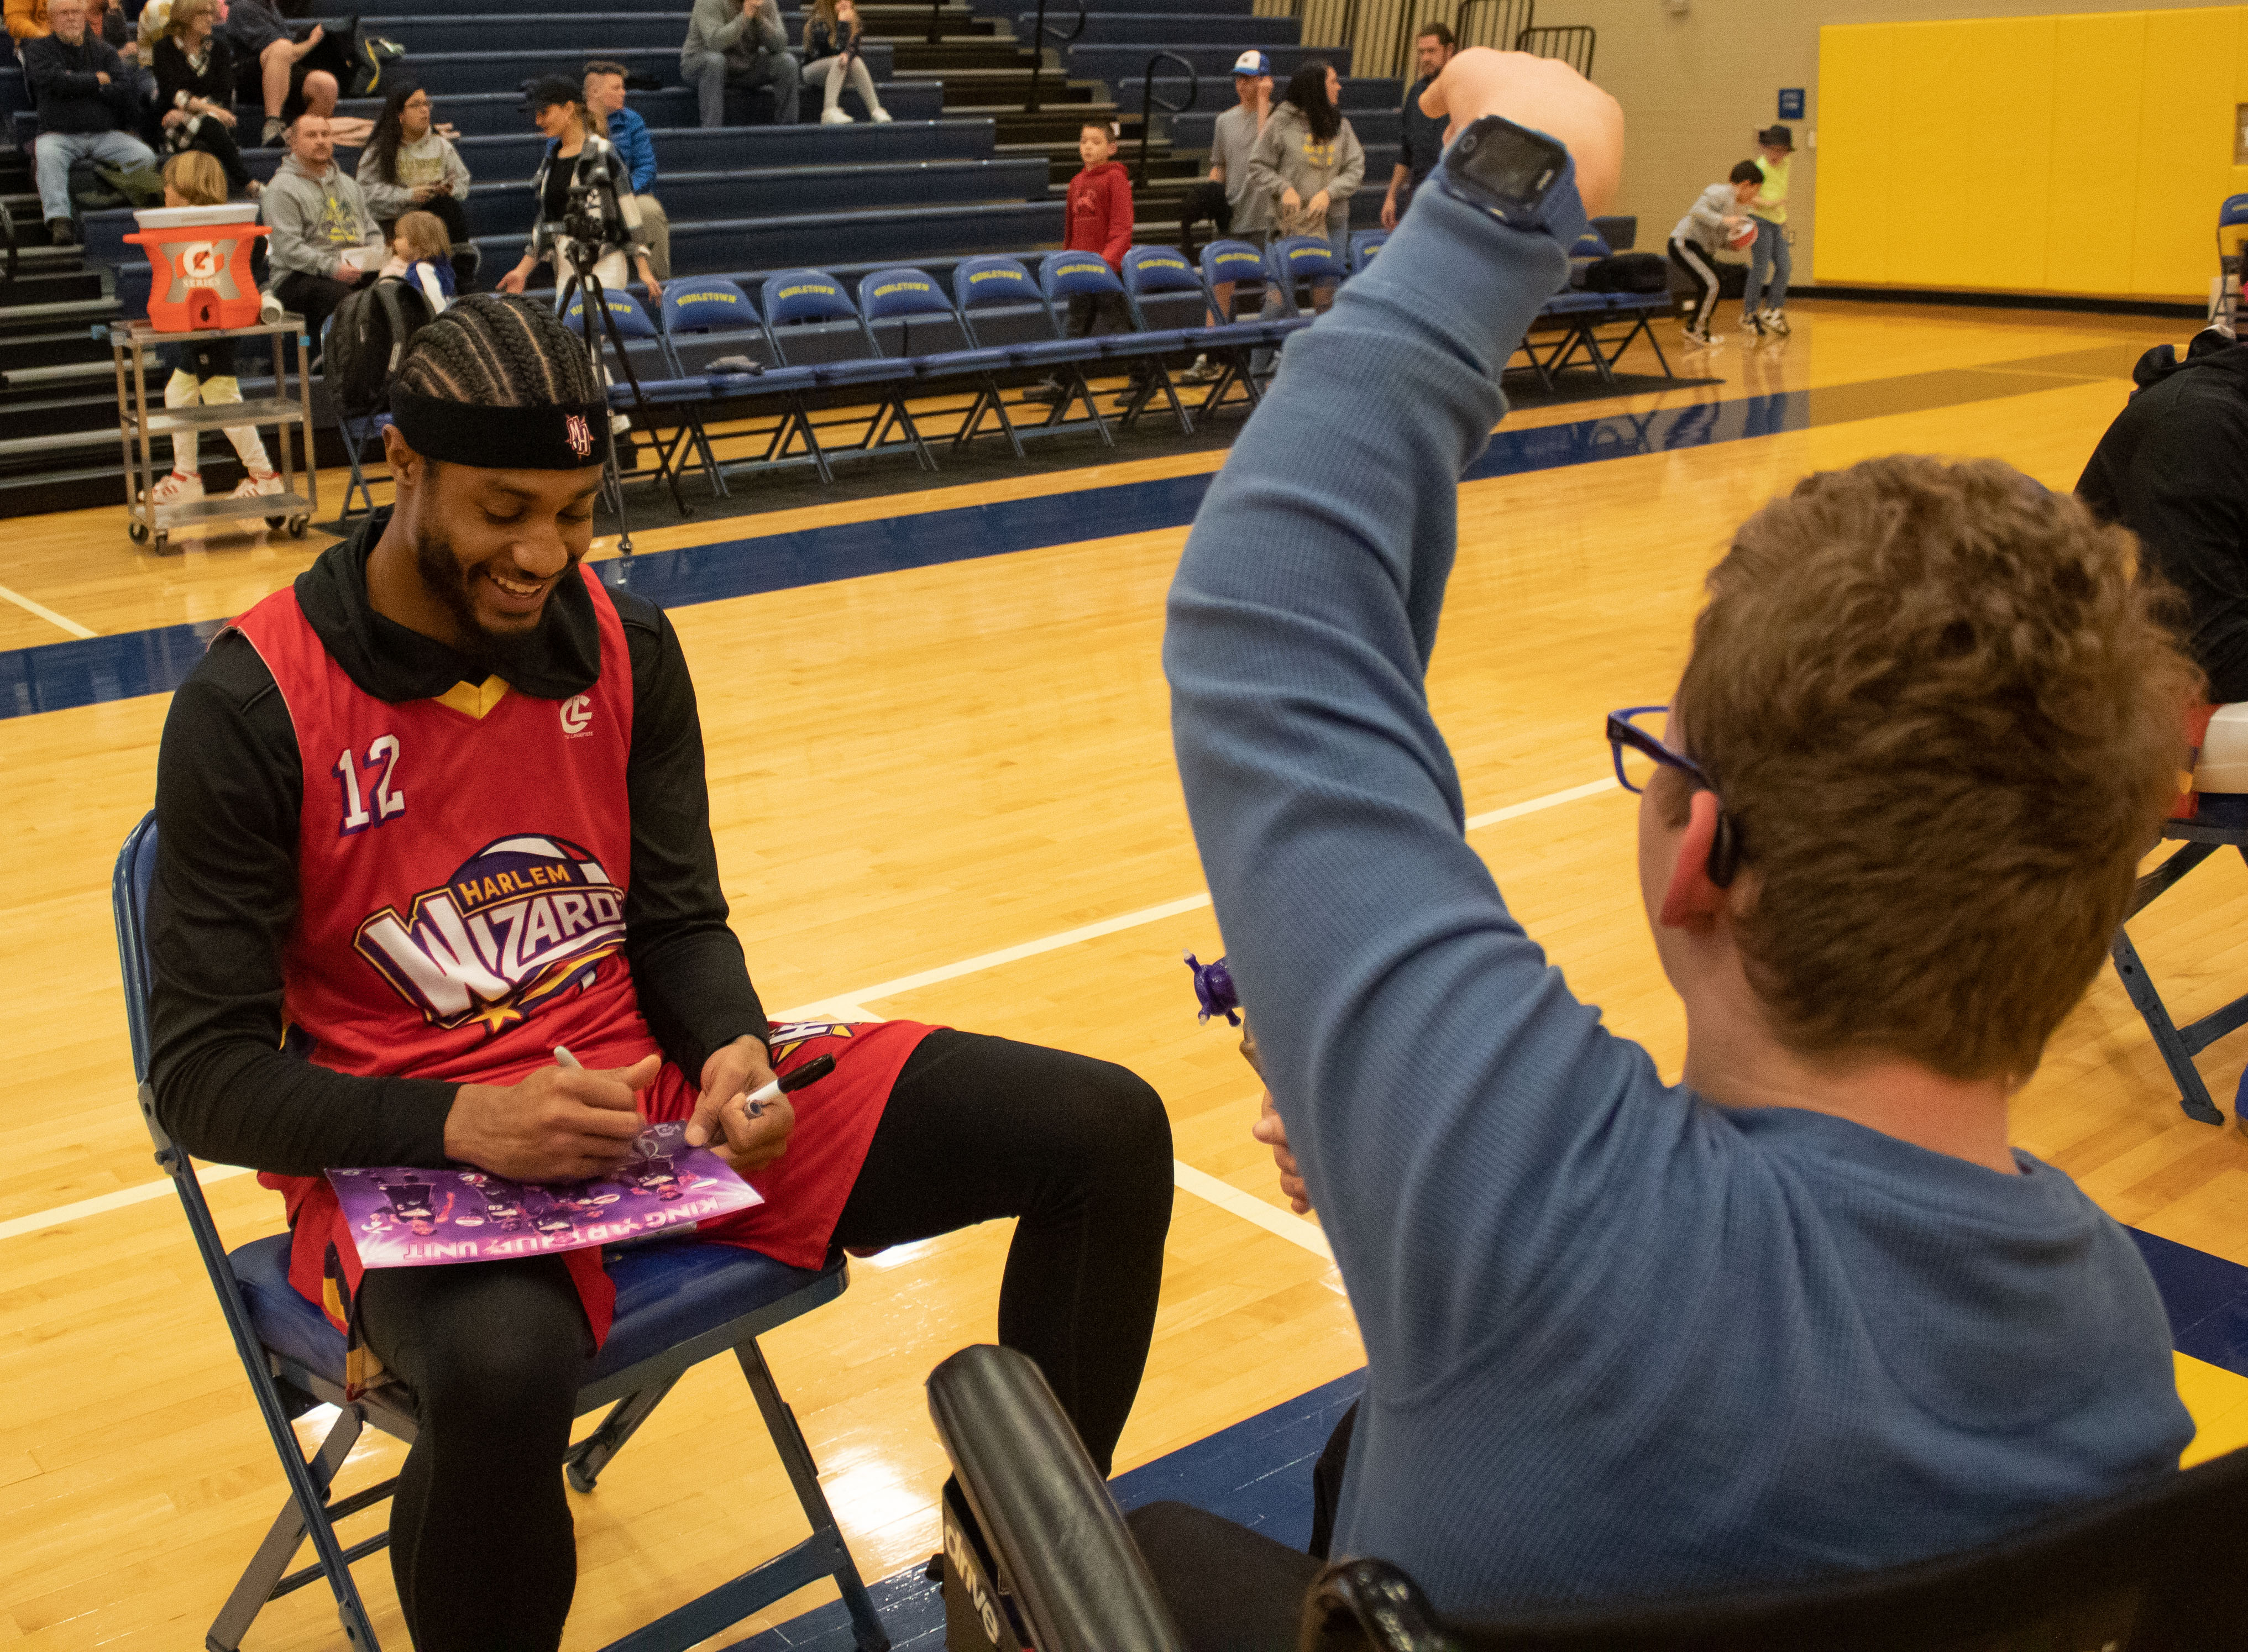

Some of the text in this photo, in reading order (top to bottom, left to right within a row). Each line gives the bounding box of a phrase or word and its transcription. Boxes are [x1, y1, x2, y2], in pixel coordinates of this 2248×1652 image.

[182, 240, 216, 278] G
[676, 292, 737, 307] MIDDLETOWN
[333, 733, 405, 836] 12
[458, 864, 572, 906] HARLEM
[358, 889, 625, 1018] WIZARD
[643, 1196, 719, 1228] KING
[403, 1241, 478, 1260] UNIT
[945, 1524, 999, 1644] drive
